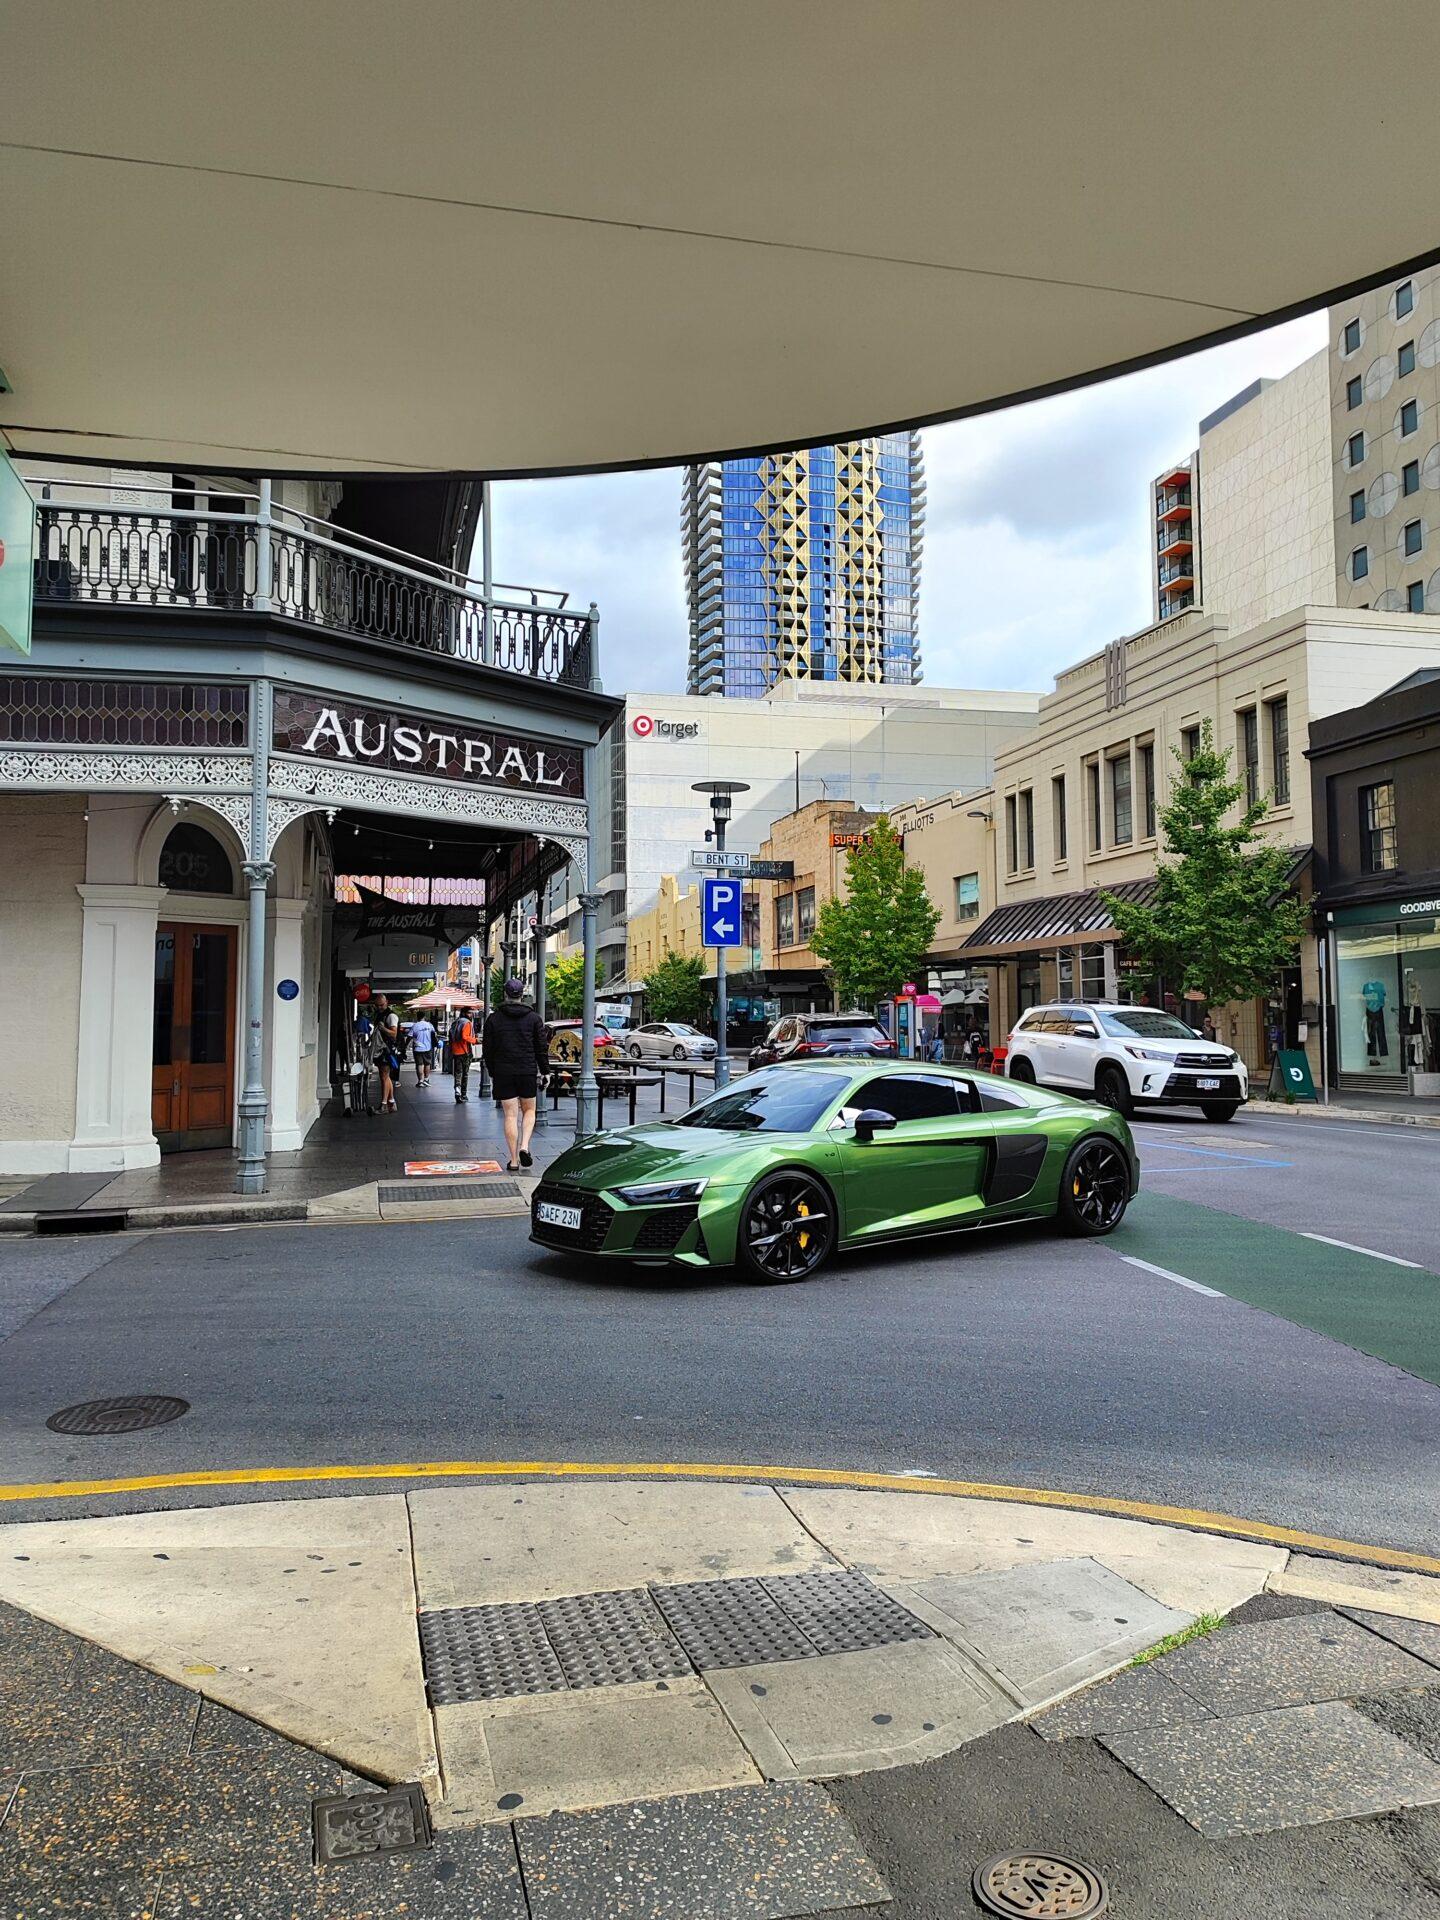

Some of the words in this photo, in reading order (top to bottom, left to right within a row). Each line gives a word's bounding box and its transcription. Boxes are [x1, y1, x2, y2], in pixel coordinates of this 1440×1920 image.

[654, 719, 699, 739] Target
[301, 707, 564, 786] AUSTRAL
[903, 812, 935, 835] ELLIOTTS
[834, 835, 864, 846] SUPER
[706, 853, 730, 865] BENT
[734, 855, 746, 866] ST
[712, 885, 734, 913] P
[1400, 899, 1440, 914] GOODBYE
[367, 916, 386, 927] THE
[386, 911, 438, 928] AUSTRAL
[409, 952, 435, 966] CUE
